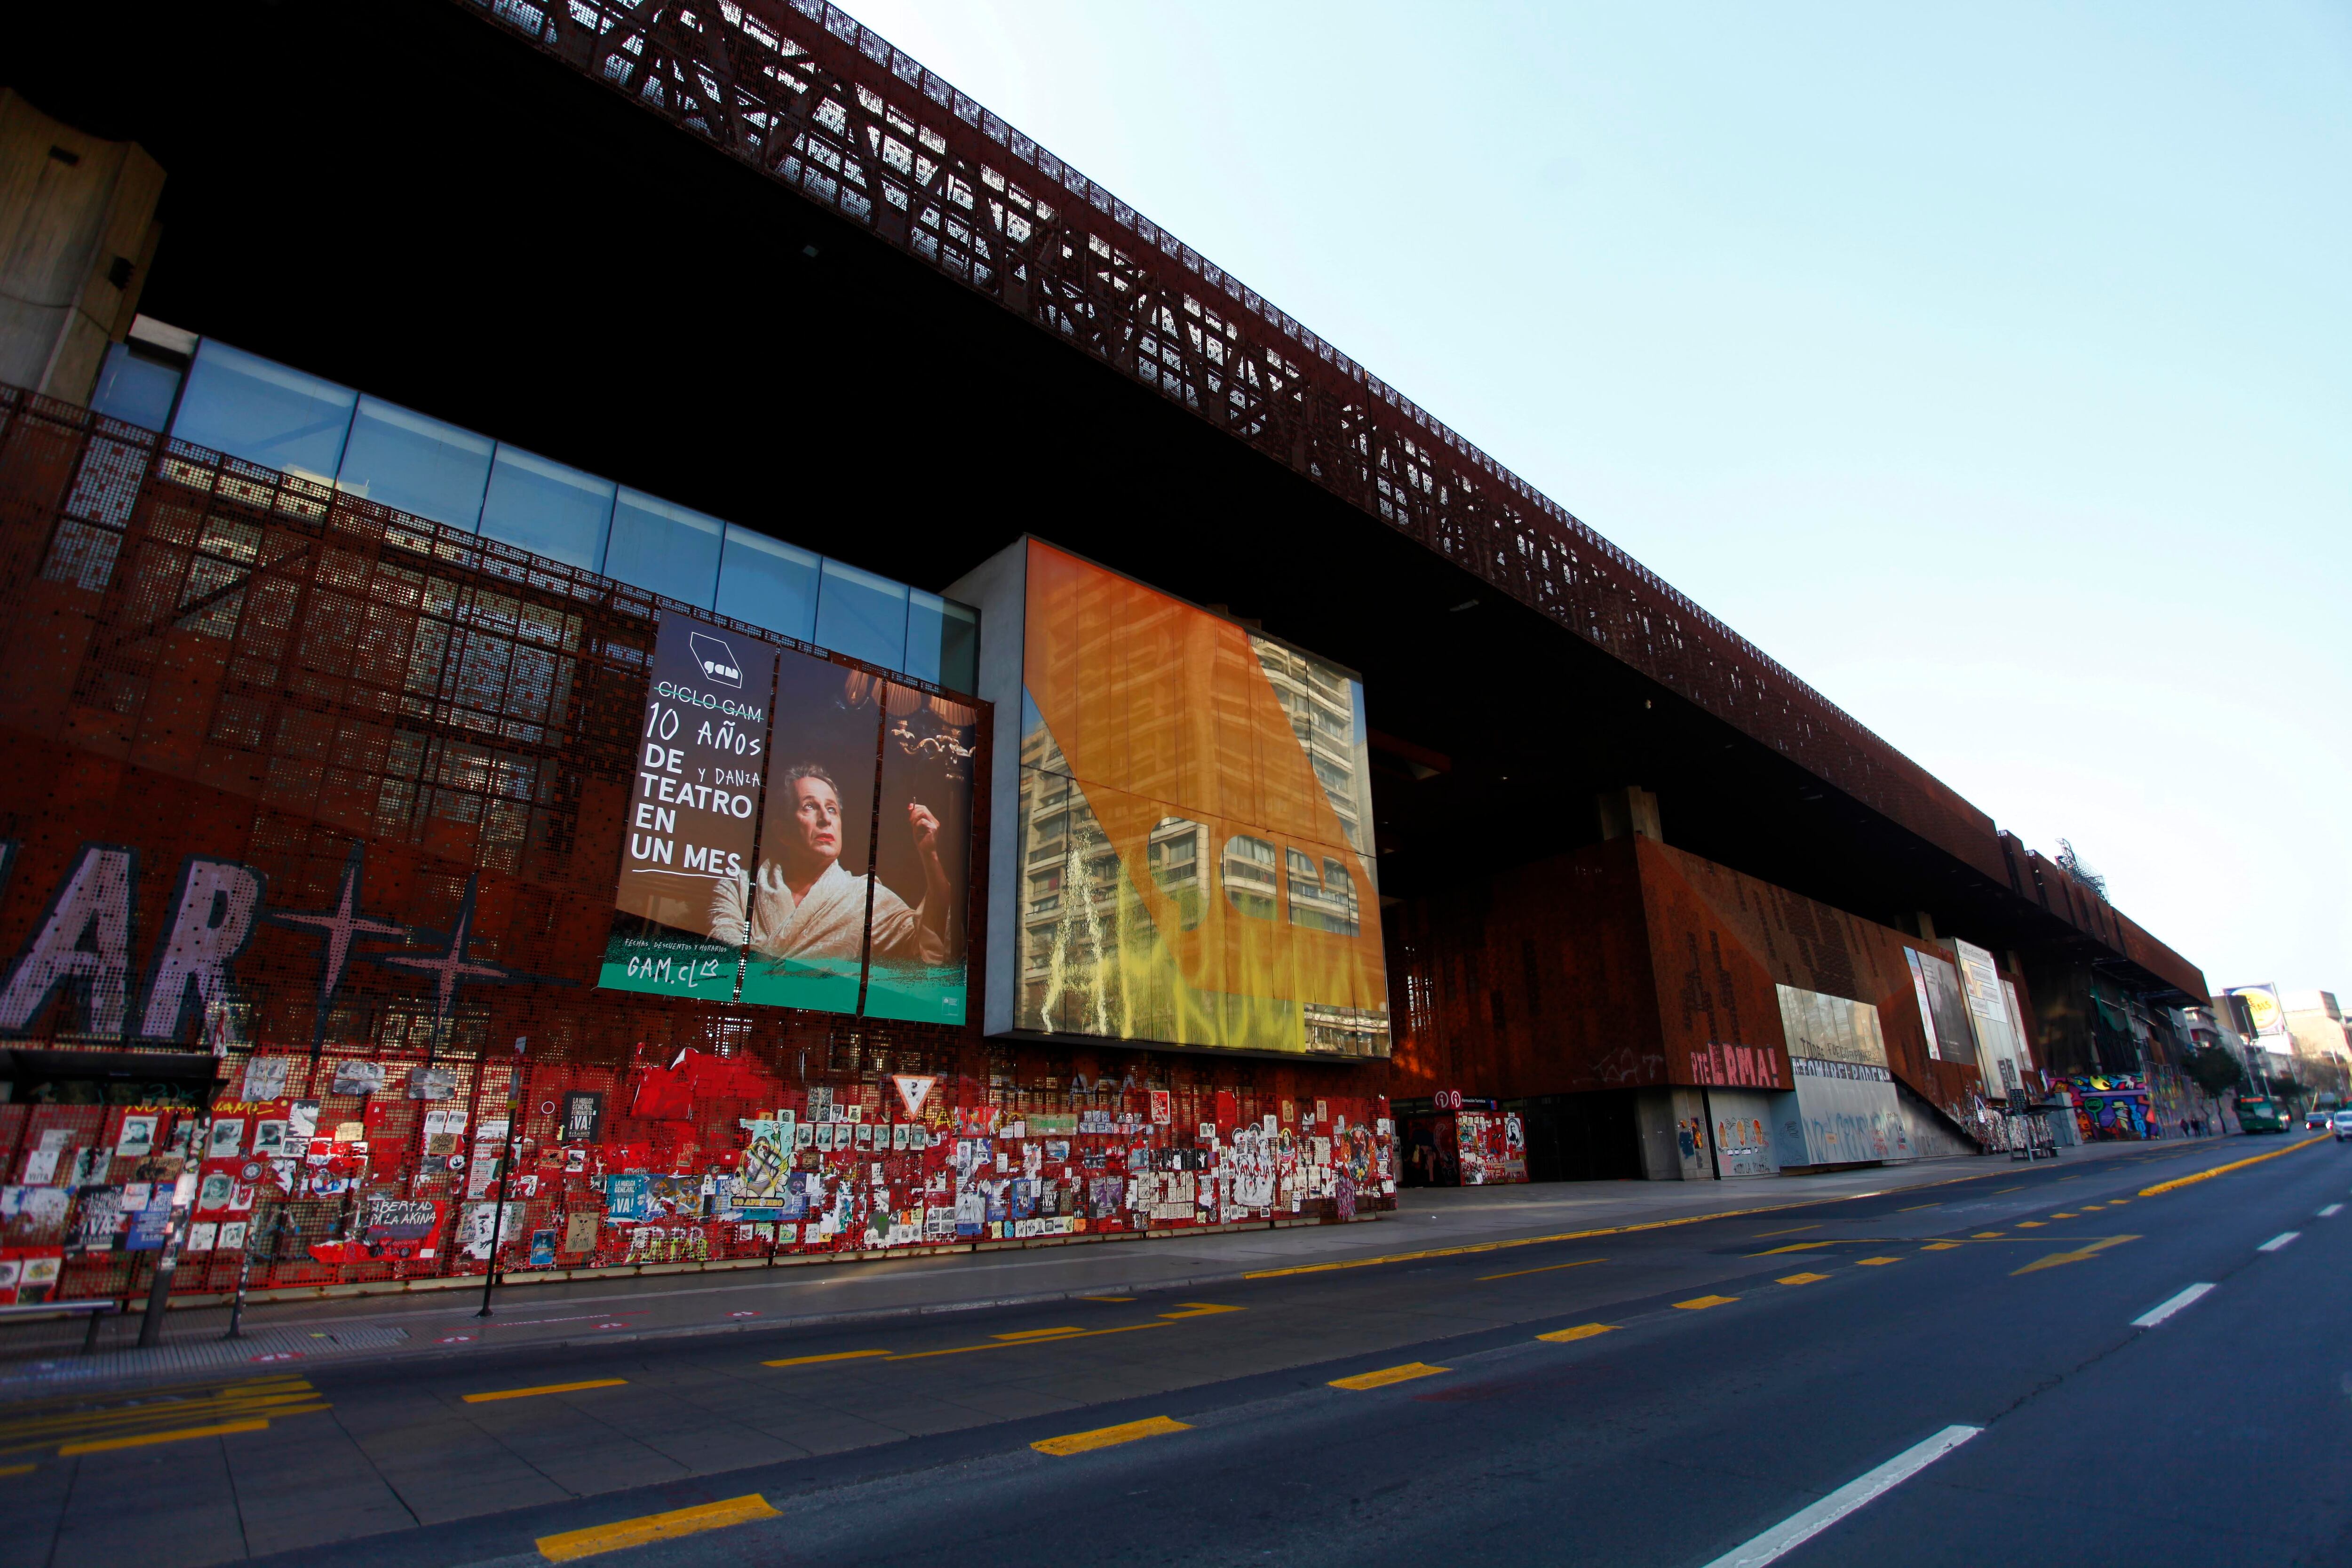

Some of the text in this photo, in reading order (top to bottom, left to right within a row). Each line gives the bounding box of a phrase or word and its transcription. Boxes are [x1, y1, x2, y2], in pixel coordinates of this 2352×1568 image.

[704, 661, 739, 679] gam
[659, 681, 761, 723] CICLO GAM
[647, 702, 761, 756] 10 AÑOS
[644, 743, 684, 774] DE
[698, 768, 706, 782] Y
[640, 772, 752, 818] TEATRO
[636, 803, 675, 834] EN
[631, 833, 740, 876] UN MES
[654, 942, 691, 950] DESCUENTOS
[570, 1115, 592, 1130] ¡VA!
[612, 1198, 634, 1213] ¡VA!
[1043, 1195, 1055, 1206] ¡VA!
